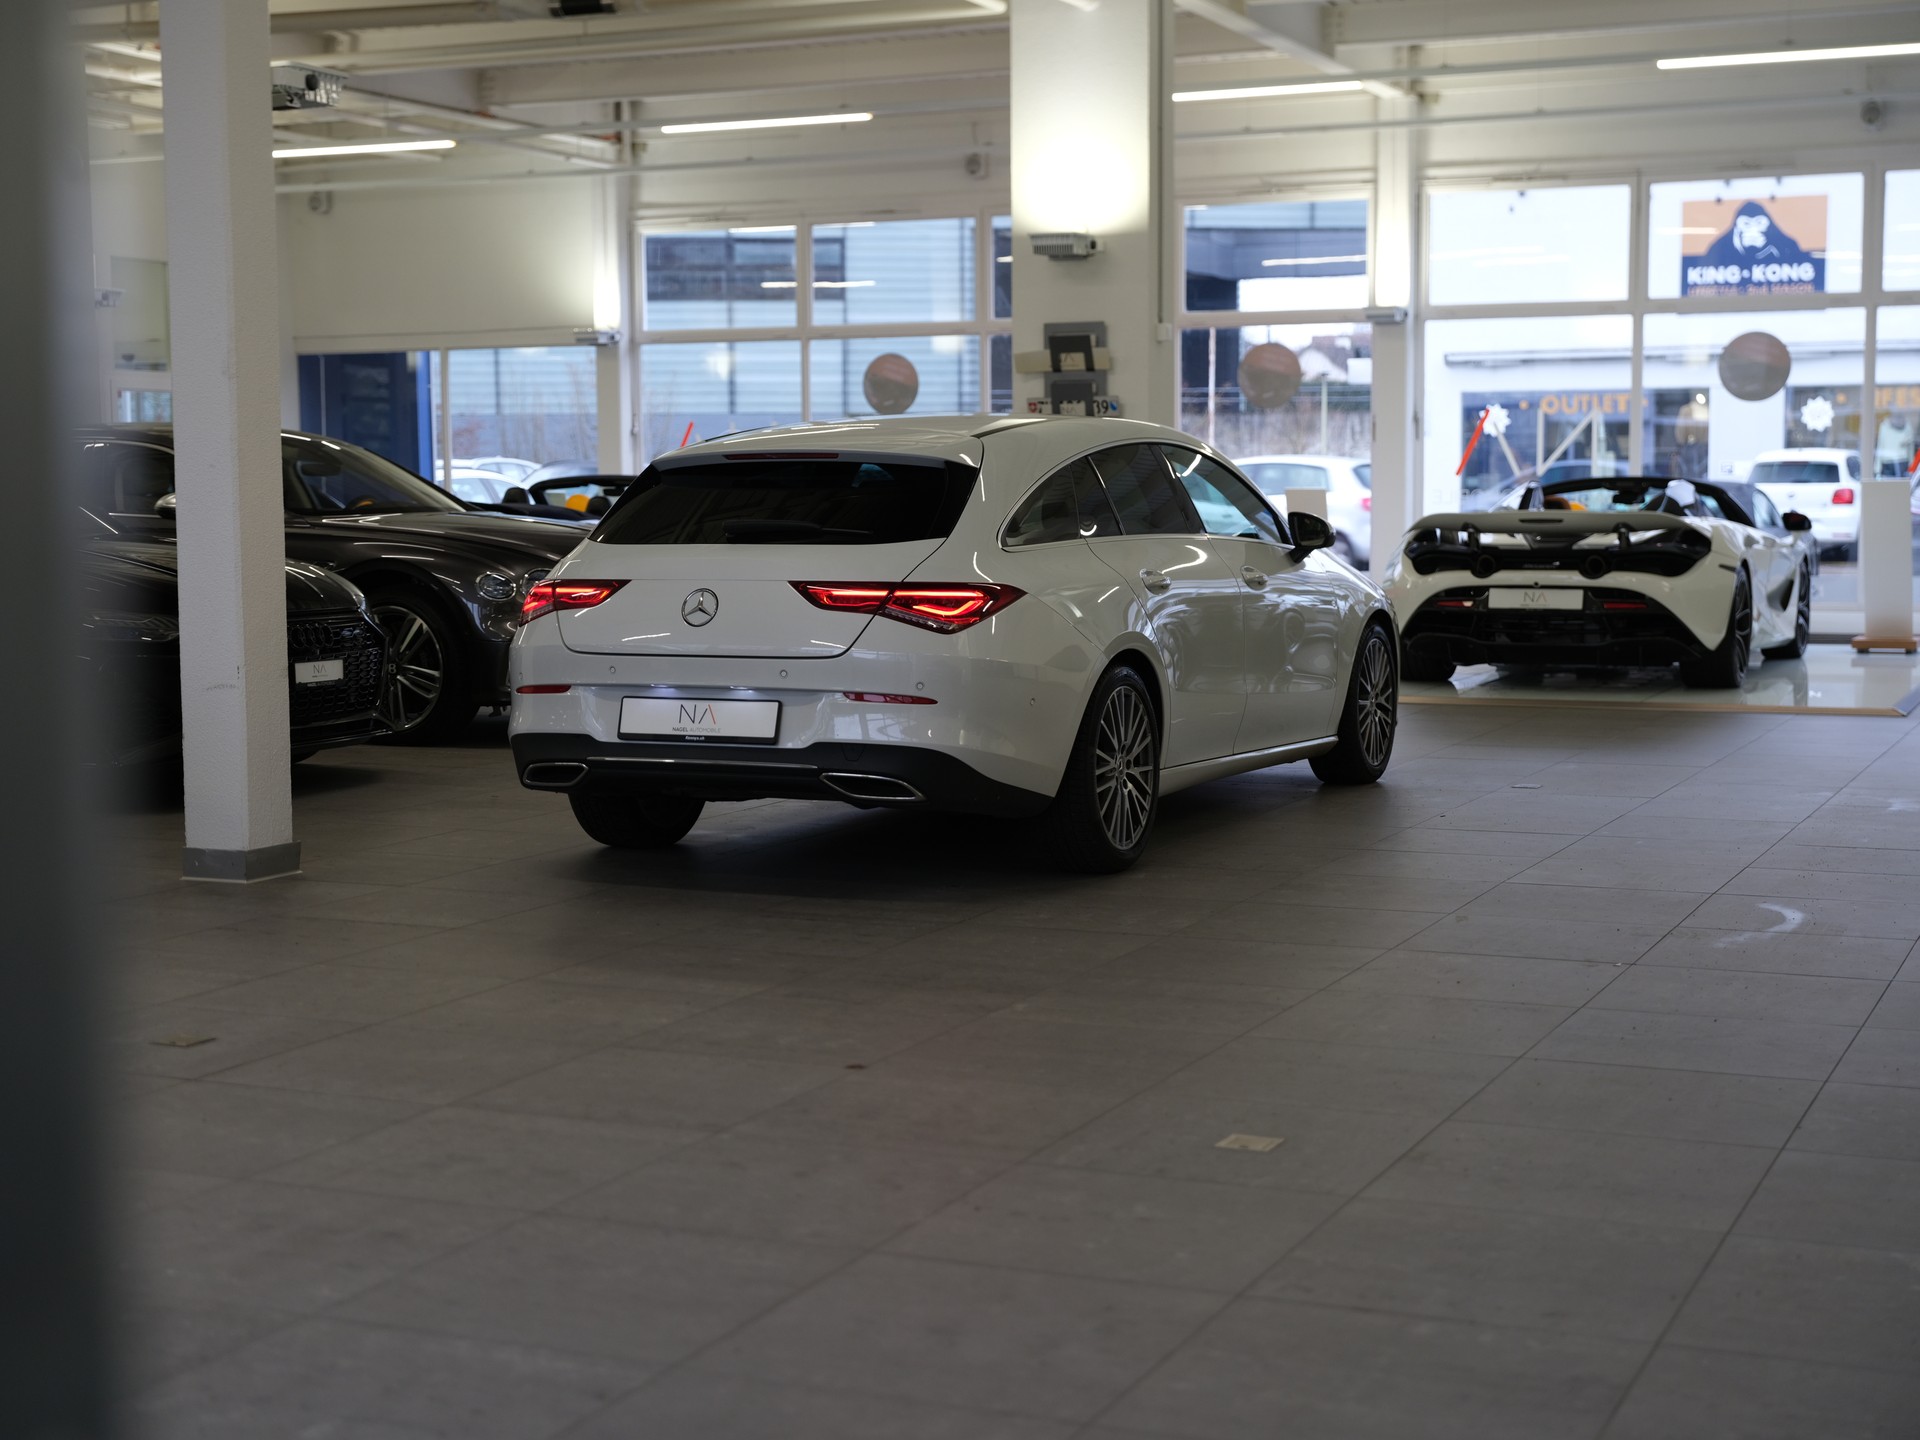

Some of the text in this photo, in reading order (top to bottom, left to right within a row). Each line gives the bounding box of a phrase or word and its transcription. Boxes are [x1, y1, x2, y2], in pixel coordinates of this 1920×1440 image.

[1752, 262, 1816, 282] KONG
[1541, 393, 1631, 414] OUTLET
[678, 704, 716, 724] NA
